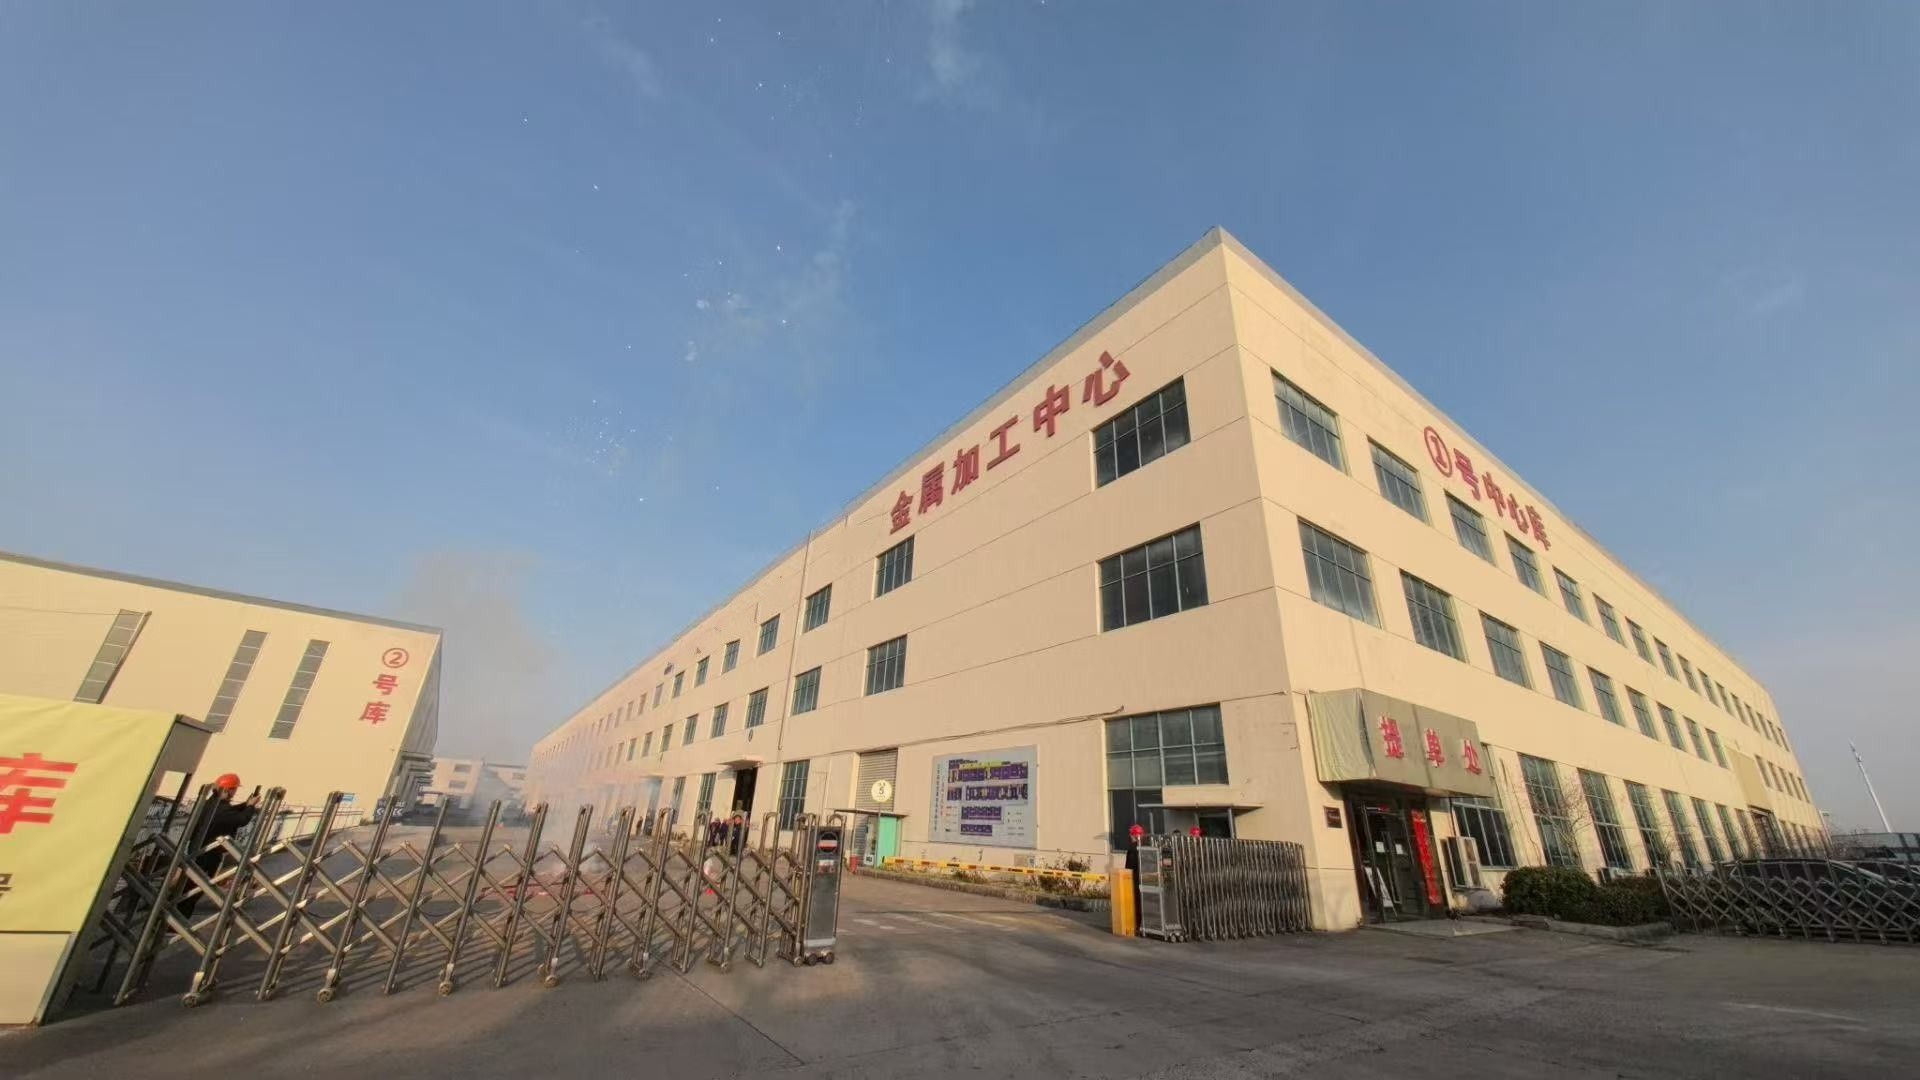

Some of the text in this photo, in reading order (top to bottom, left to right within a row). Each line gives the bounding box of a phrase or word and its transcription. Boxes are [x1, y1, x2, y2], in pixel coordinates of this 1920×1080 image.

[889, 350, 1131, 535] 金属加工中心
[1378, 712, 1482, 775] 提单处
